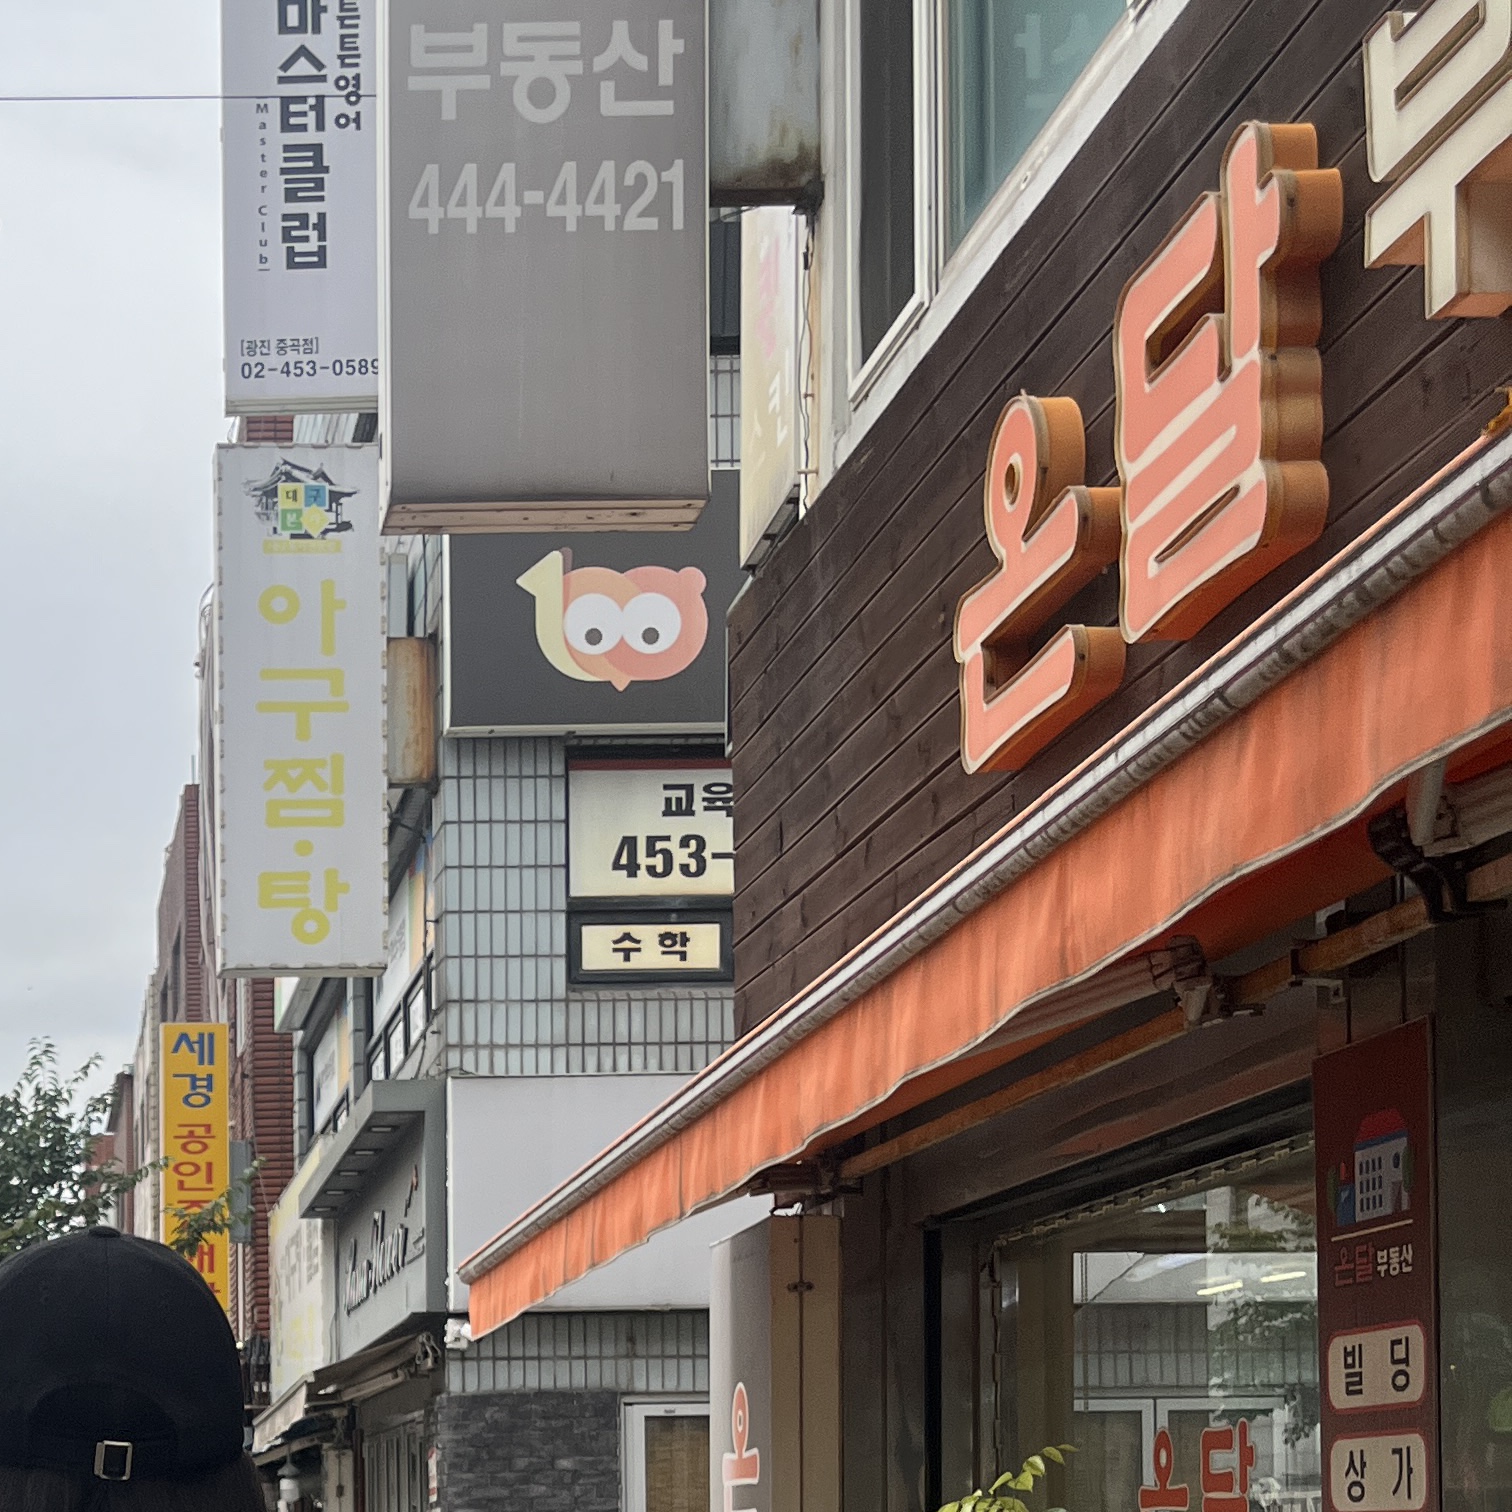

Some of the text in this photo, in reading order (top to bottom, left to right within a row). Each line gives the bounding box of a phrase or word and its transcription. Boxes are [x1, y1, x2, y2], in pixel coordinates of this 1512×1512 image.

[407, 18, 685, 124] 부동산
[255, 103, 270, 266] Master Club
[407, 158, 685, 235] 444-4421
[240, 358, 379, 380] 02-453-0589
[661, 782, 735, 818] 교육
[611, 834, 735, 879] 453-
[1333, 1241, 1414, 1287] 온달 부동산
[1343, 1335, 1411, 1397] 빌딩
[1344, 1445, 1414, 1504] 상가
